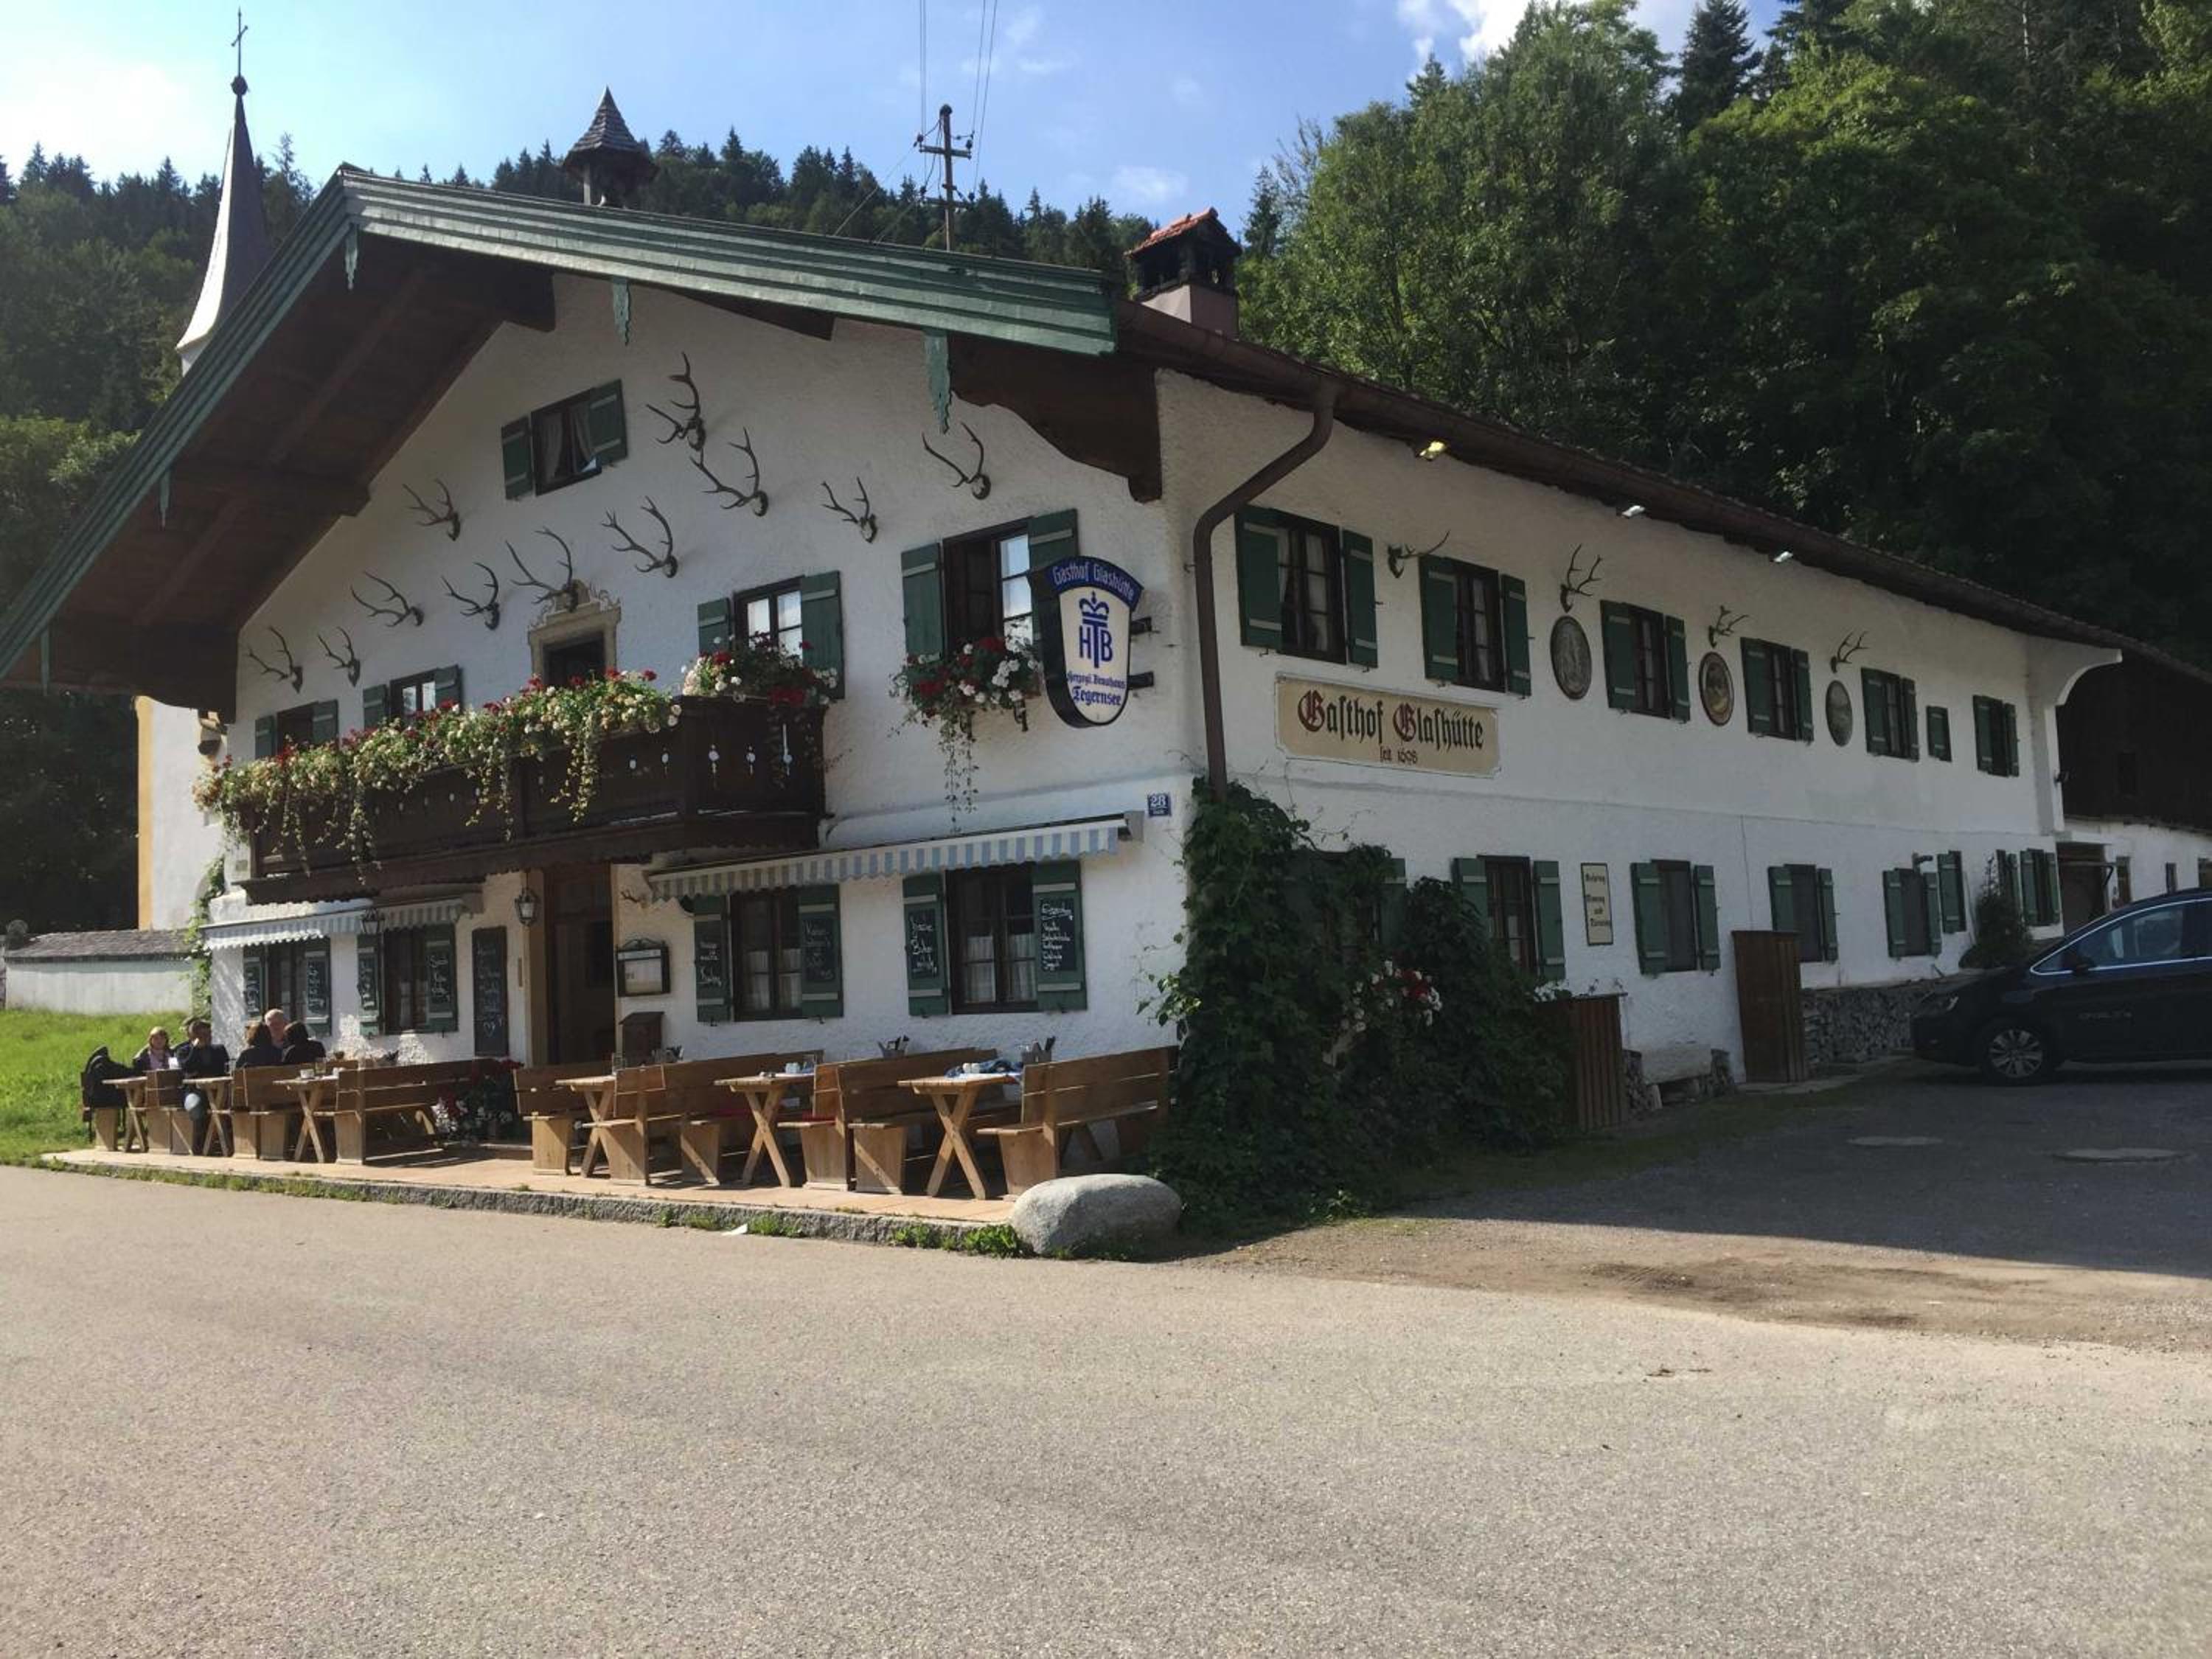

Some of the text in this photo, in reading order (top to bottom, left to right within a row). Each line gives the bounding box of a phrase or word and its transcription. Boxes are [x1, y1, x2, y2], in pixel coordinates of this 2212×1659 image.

[1052, 561, 1135, 601] Gasthof Glashütte
[1079, 619, 1113, 668] HTB
[1072, 686, 1121, 706] Tegernsee
